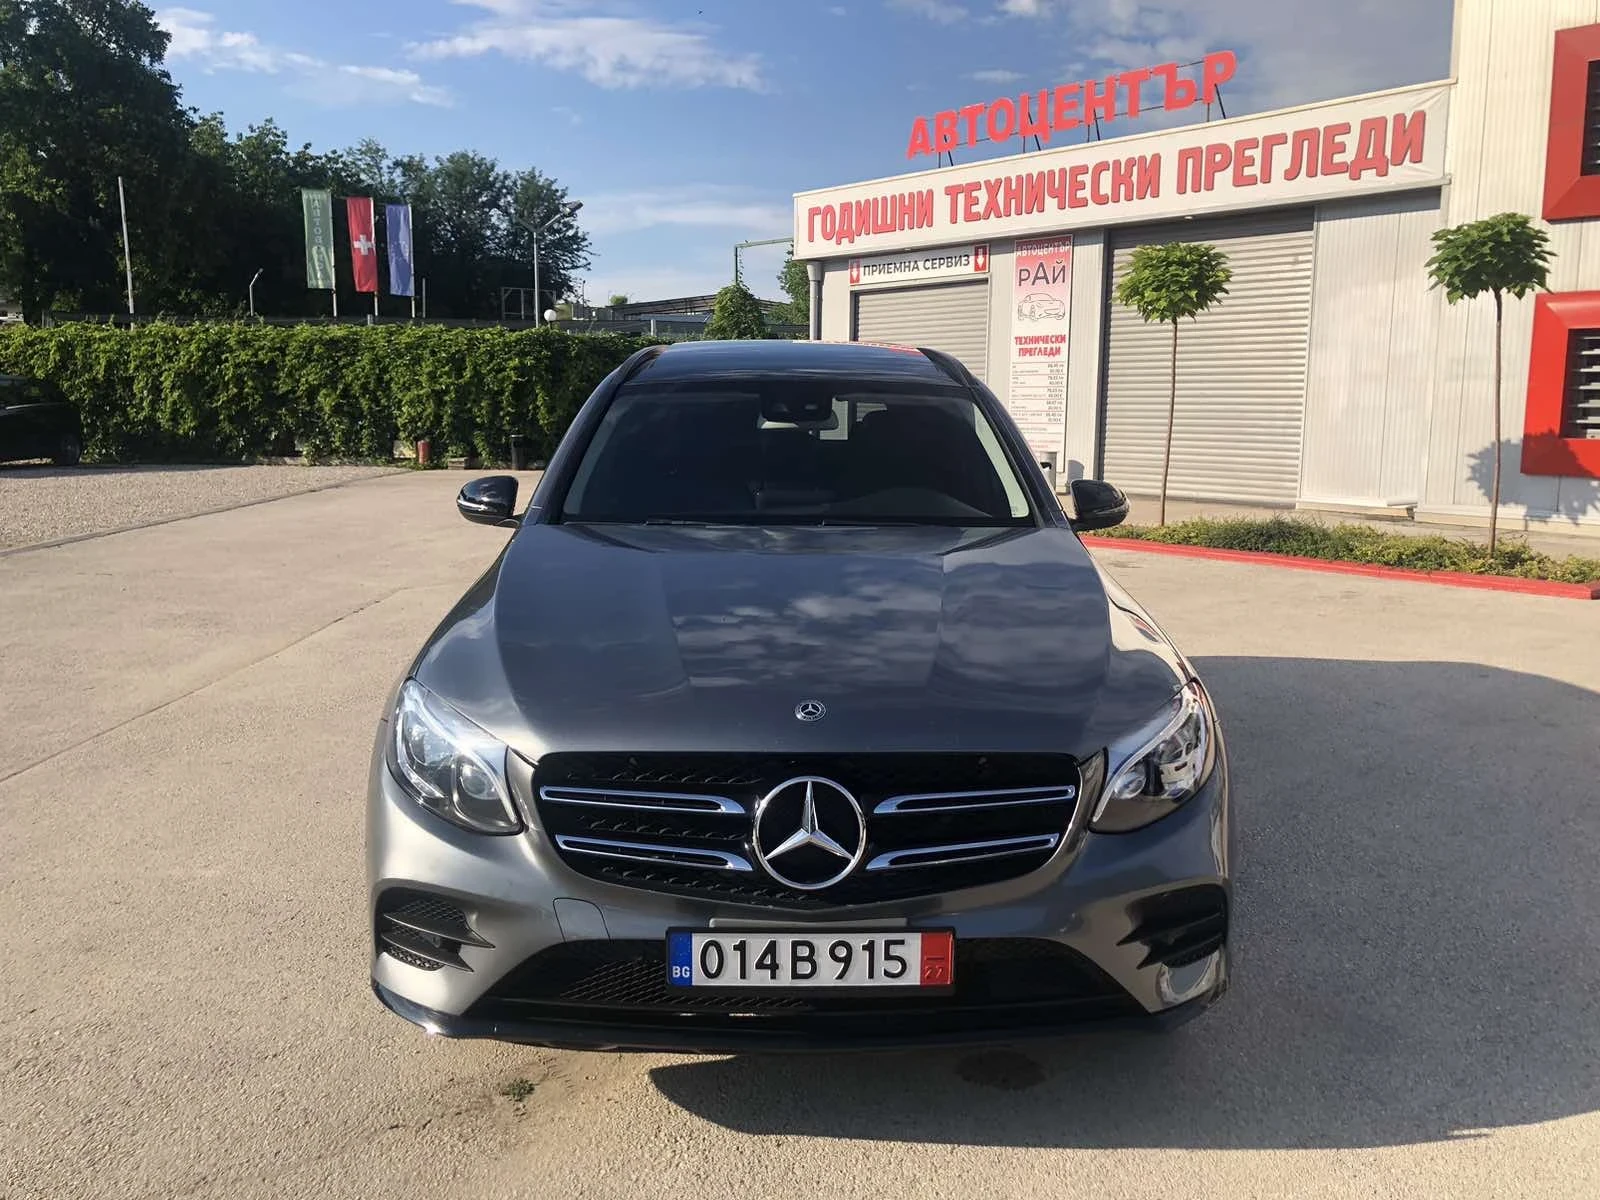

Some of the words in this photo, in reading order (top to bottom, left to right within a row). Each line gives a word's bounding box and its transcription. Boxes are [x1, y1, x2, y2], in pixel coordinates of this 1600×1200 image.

[907, 50, 1237, 159] АВТОЦЕНТЪР
[807, 188, 934, 244] ГОДИШНИ
[944, 153, 1161, 224] ТЕХНИЧЕСКИ
[1177, 110, 1426, 195] ПРЕГЛЕДИ
[1016, 241, 1070, 256] АВТОЦЕНТЪР
[863, 260, 920, 276] ПРИЕМНА
[923, 254, 970, 271] СЕРВИЗ
[1018, 259, 1066, 287] РАЙ
[1014, 335, 1066, 345] ТЕХНИЧЕСКИ
[1018, 346, 1061, 357] ПРЕГЛЕДИ
[672, 965, 690, 978] BG
[699, 939, 907, 980] 014B915
